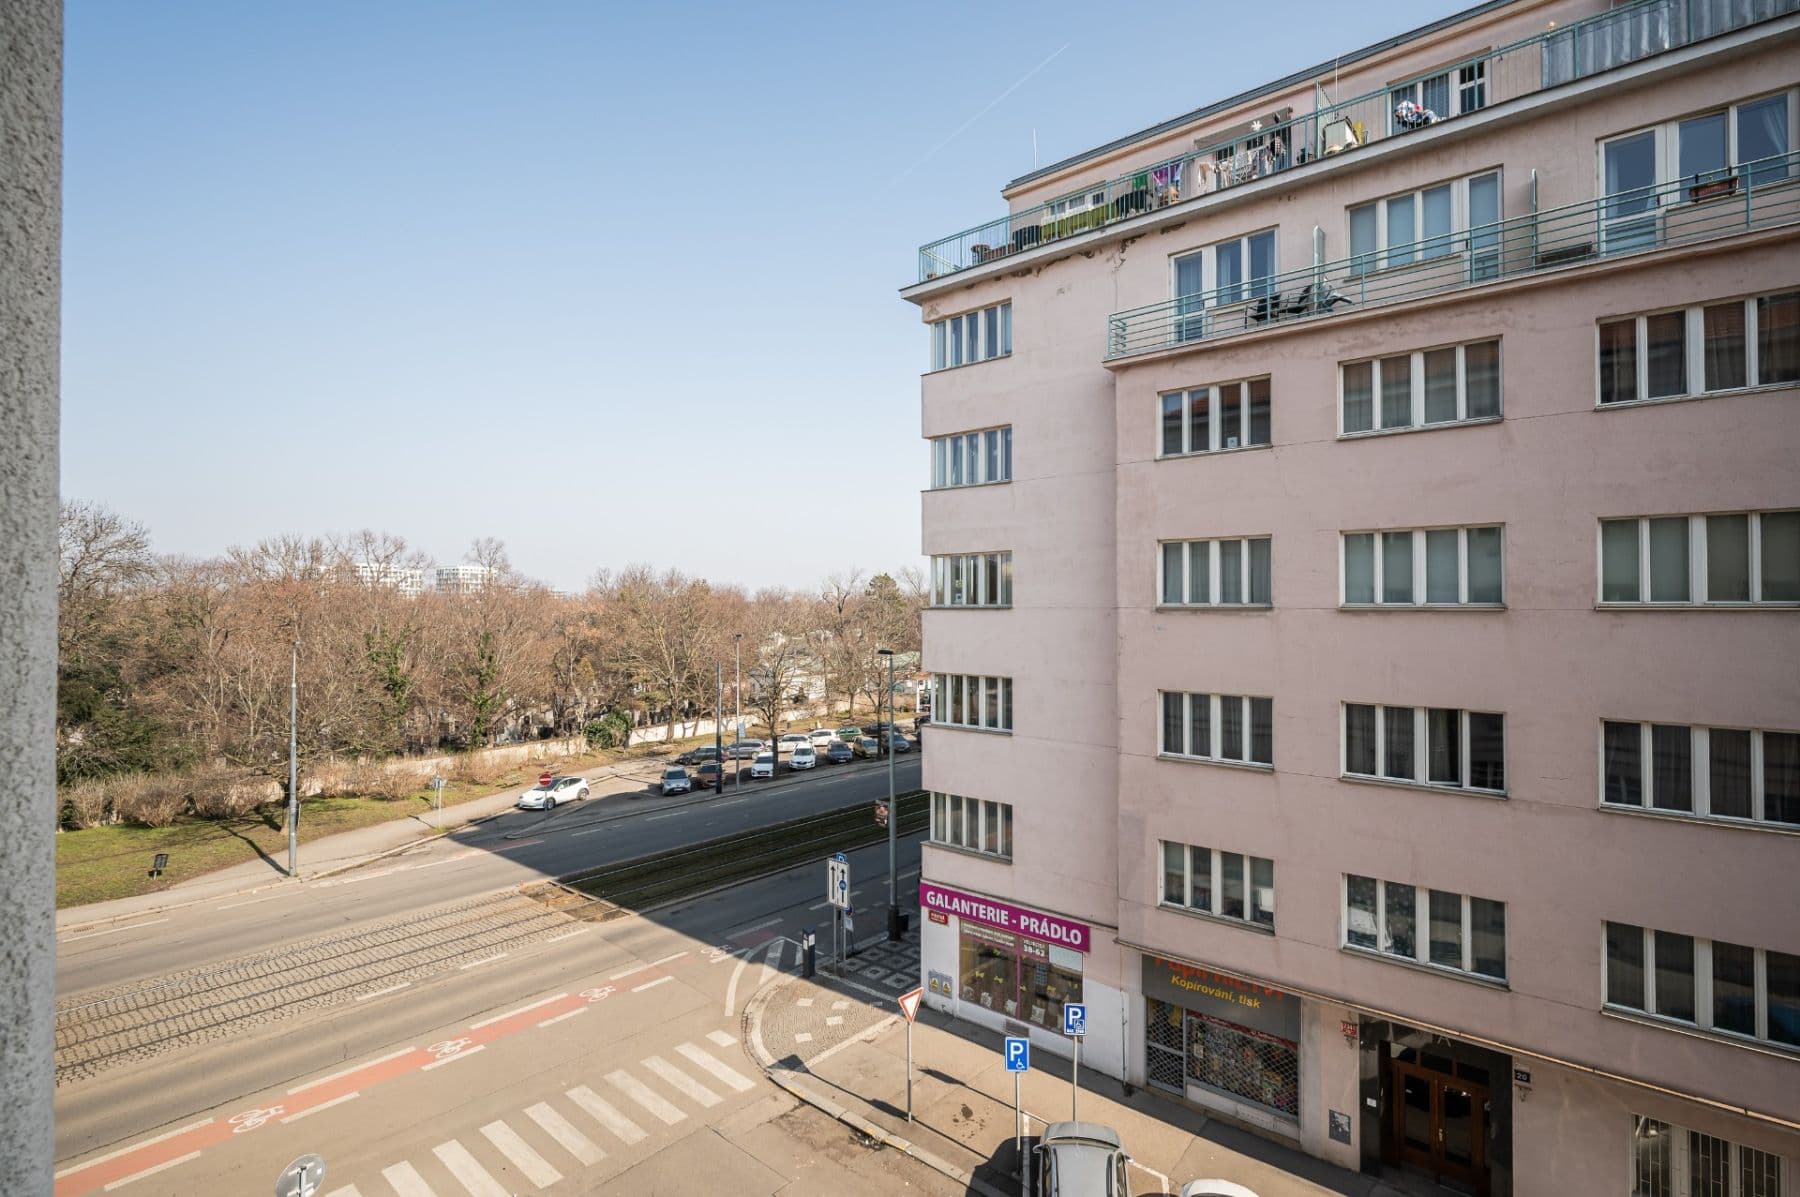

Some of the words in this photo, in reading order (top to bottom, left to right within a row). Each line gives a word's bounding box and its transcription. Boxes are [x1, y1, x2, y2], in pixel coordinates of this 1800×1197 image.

[926, 890, 1009, 926] GALANTERIE
[1020, 915, 1082, 945] PRÁDLO
[1238, 994, 1262, 1008] tisk
[1069, 1007, 1082, 1025] P
[1010, 1042, 1024, 1062] P
